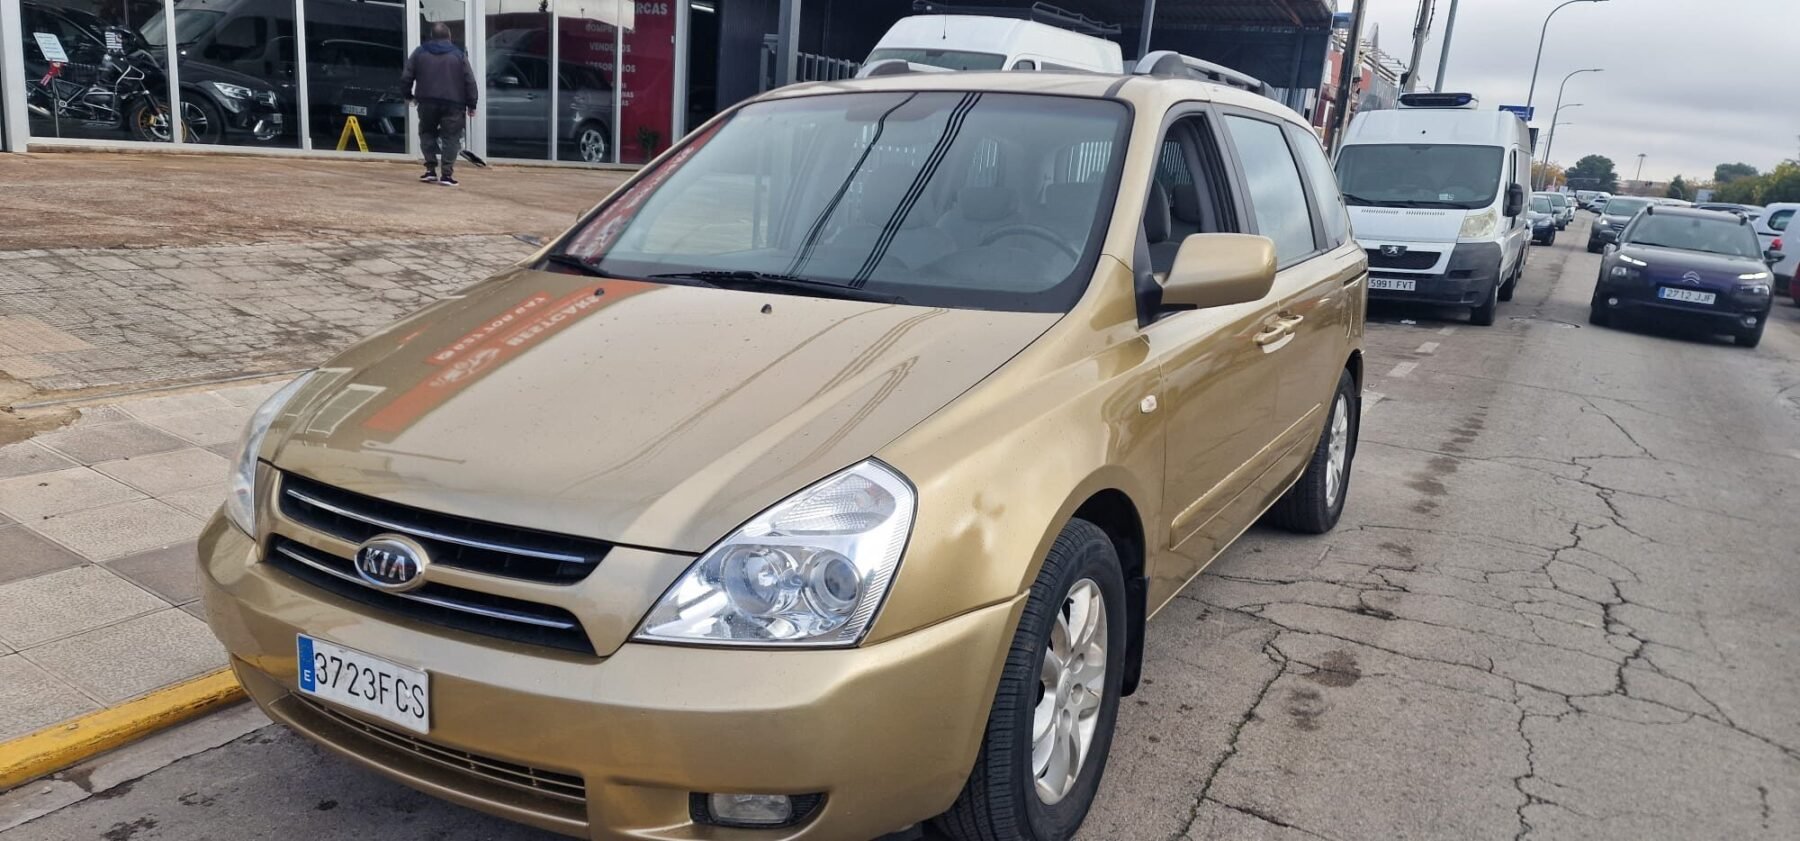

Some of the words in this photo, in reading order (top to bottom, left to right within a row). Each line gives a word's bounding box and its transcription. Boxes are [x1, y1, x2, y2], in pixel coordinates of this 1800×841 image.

[1370, 279, 1392, 288] 5991
[1396, 280, 1414, 289] FVT
[362, 547, 406, 582] KIA
[303, 669, 312, 682] E
[314, 652, 425, 719] 3723FCS
